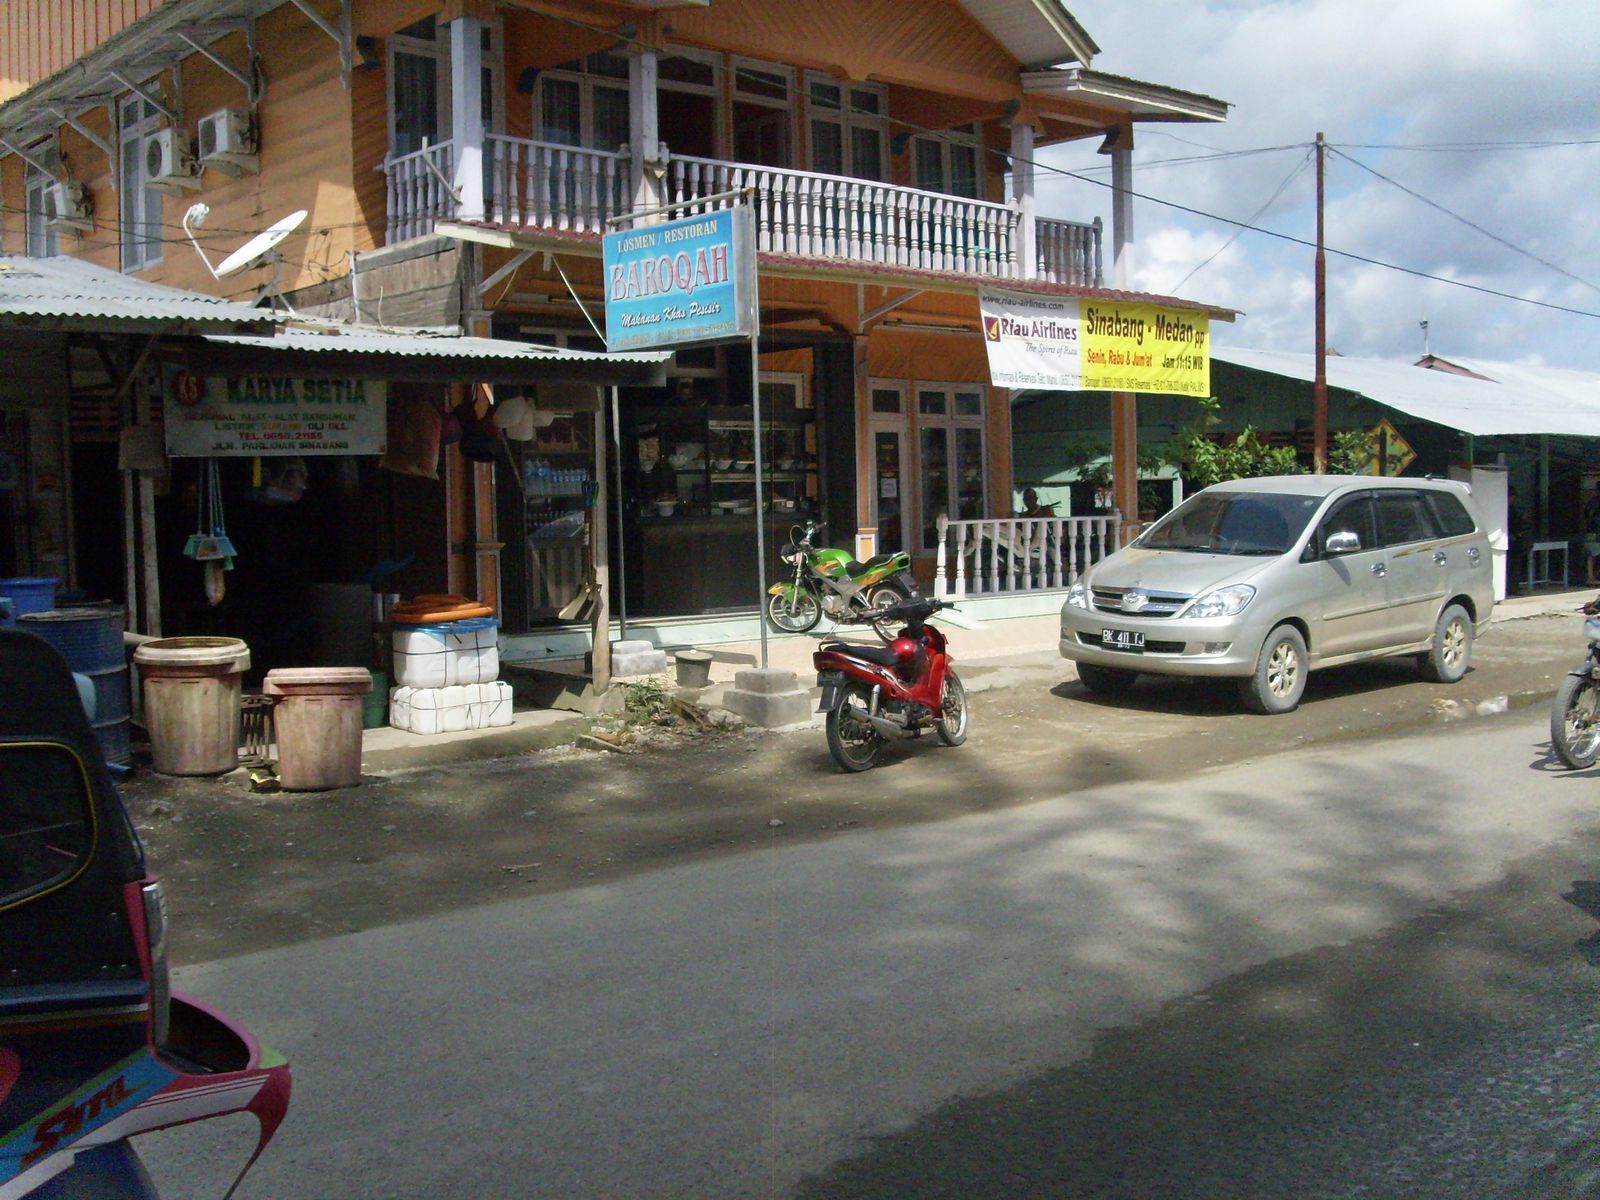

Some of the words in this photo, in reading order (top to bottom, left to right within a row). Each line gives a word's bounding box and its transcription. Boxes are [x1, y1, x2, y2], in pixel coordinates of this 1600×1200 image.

[617, 233, 656, 253] LOSMEN
[664, 220, 718, 244] RESTORAN
[609, 242, 729, 302] BAROQAH
[621, 313, 661, 328] Makanan
[663, 306, 687, 322] Khas
[689, 301, 722, 317] Pesisir
[982, 294, 1064, 310] www.riau-airlines.com
[1001, 318, 1029, 337] Riau
[1031, 320, 1077, 340] Airlines
[1086, 307, 1145, 346] Sinabang
[1155, 314, 1194, 343] Medan
[1087, 348, 1107, 368] Senin,
[1108, 350, 1124, 365] Rabu
[1162, 354, 1176, 368] Jam
[228, 377, 295, 405] KARYA
[303, 378, 367, 404] SETIA
[1103, 629, 1114, 641] BK
[1117, 632, 1130, 643] 411
[1134, 633, 1145, 645] TJ
